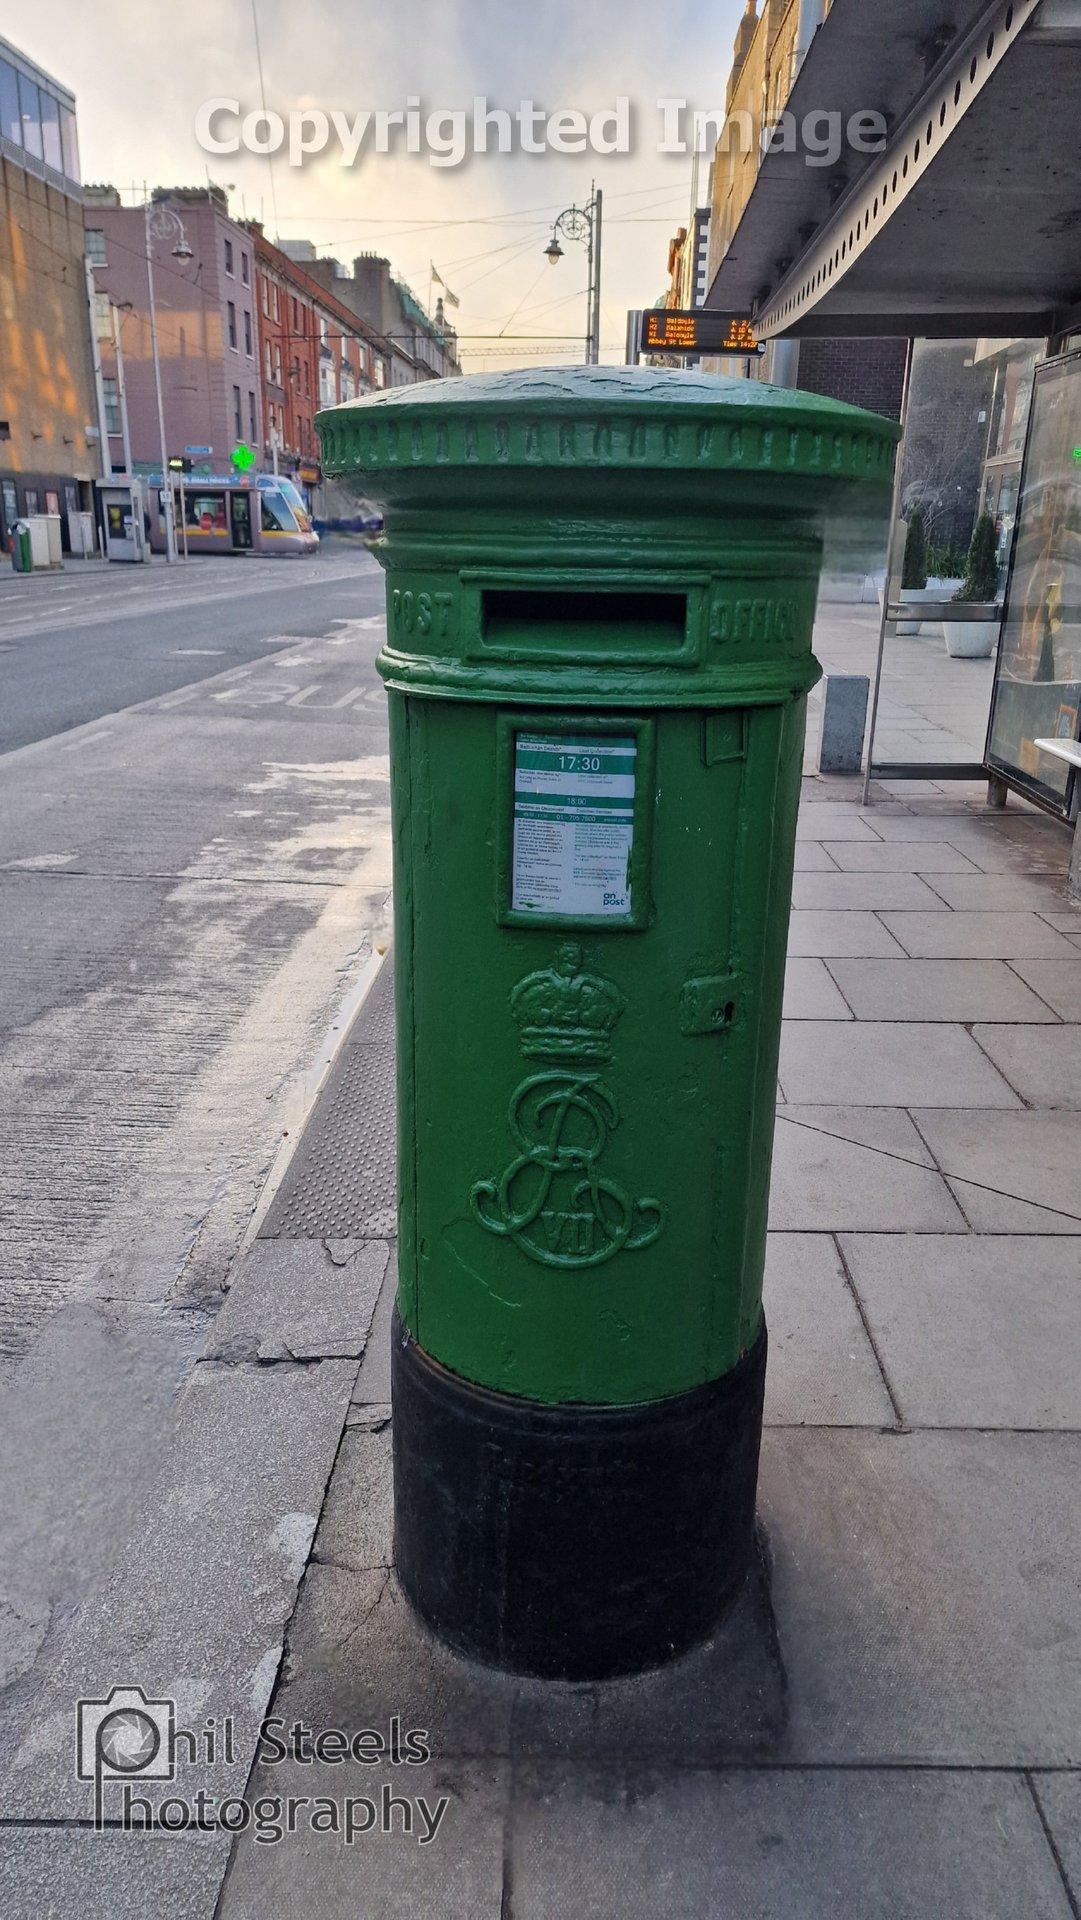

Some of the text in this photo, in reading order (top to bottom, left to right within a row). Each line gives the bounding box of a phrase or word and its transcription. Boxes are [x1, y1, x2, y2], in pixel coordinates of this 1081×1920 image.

[392, 589, 453, 636] POST
[558, 756, 600, 771] 17:30
[603, 898, 625, 907] post
